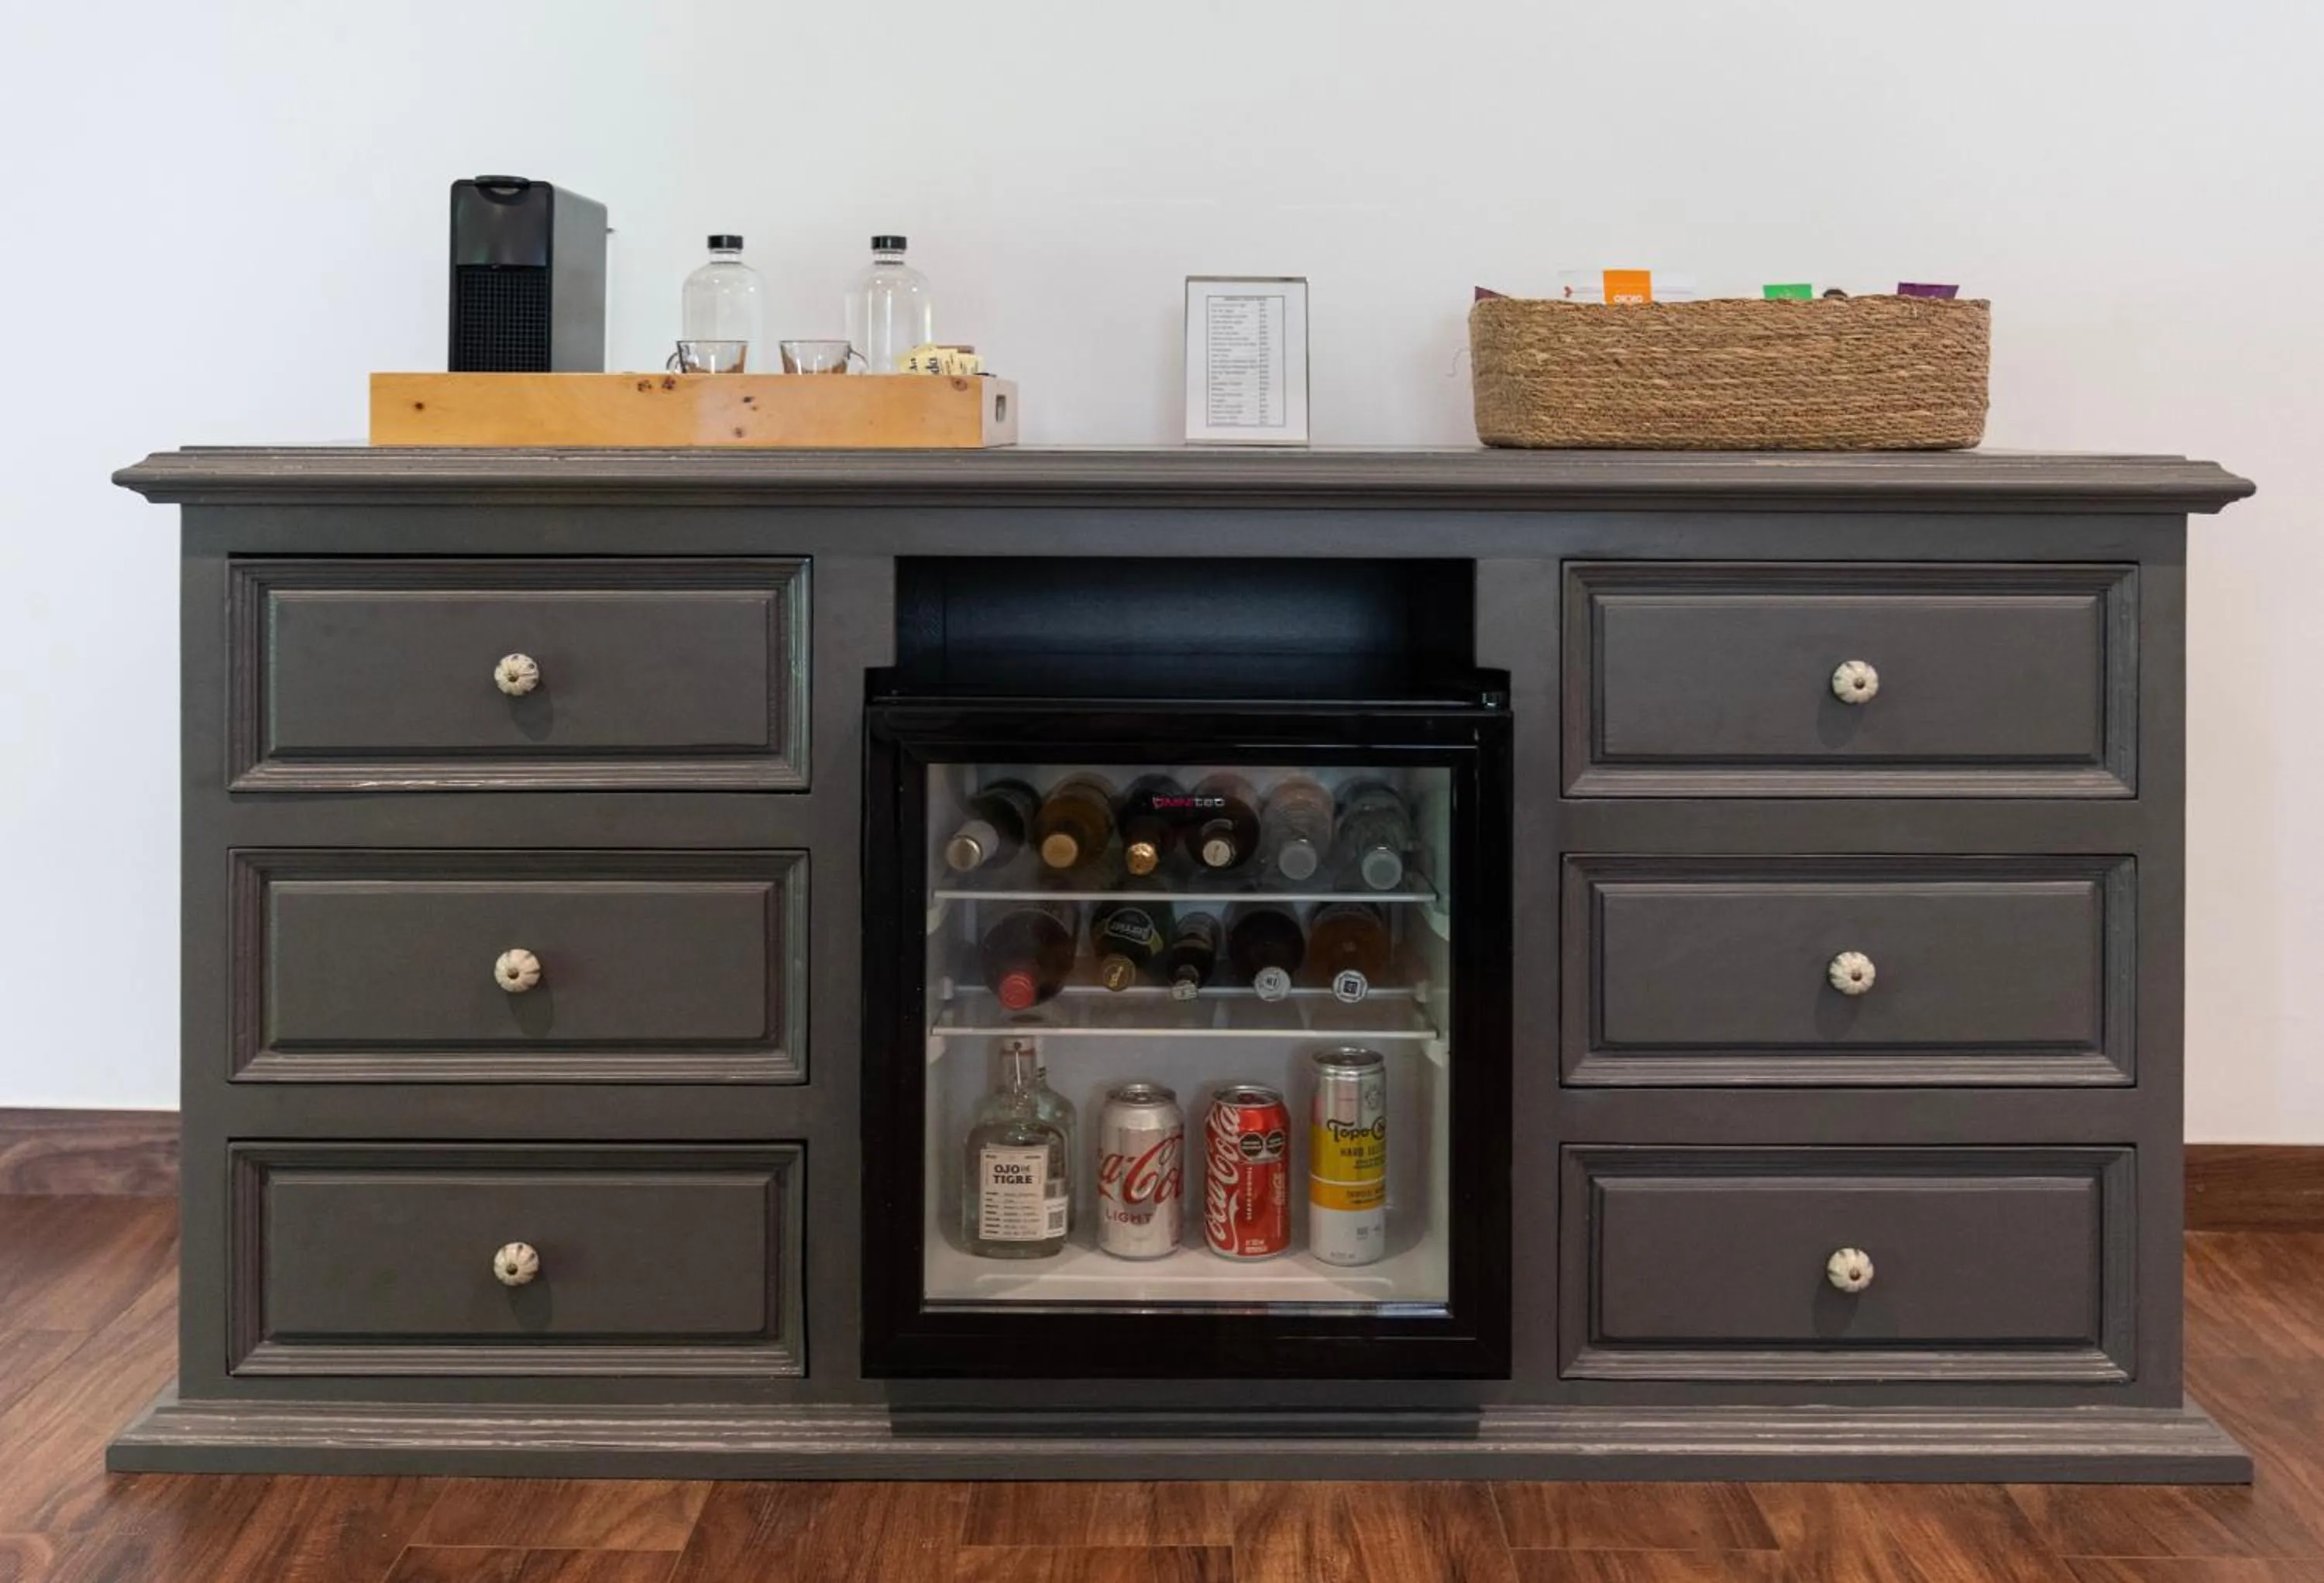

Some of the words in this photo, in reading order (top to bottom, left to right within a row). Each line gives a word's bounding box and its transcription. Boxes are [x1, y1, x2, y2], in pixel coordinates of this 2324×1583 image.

[994, 1164, 1020, 1174] OJO
[993, 1174, 1033, 1184] TIGRE
[1105, 1206, 1153, 1225] LIGHT
